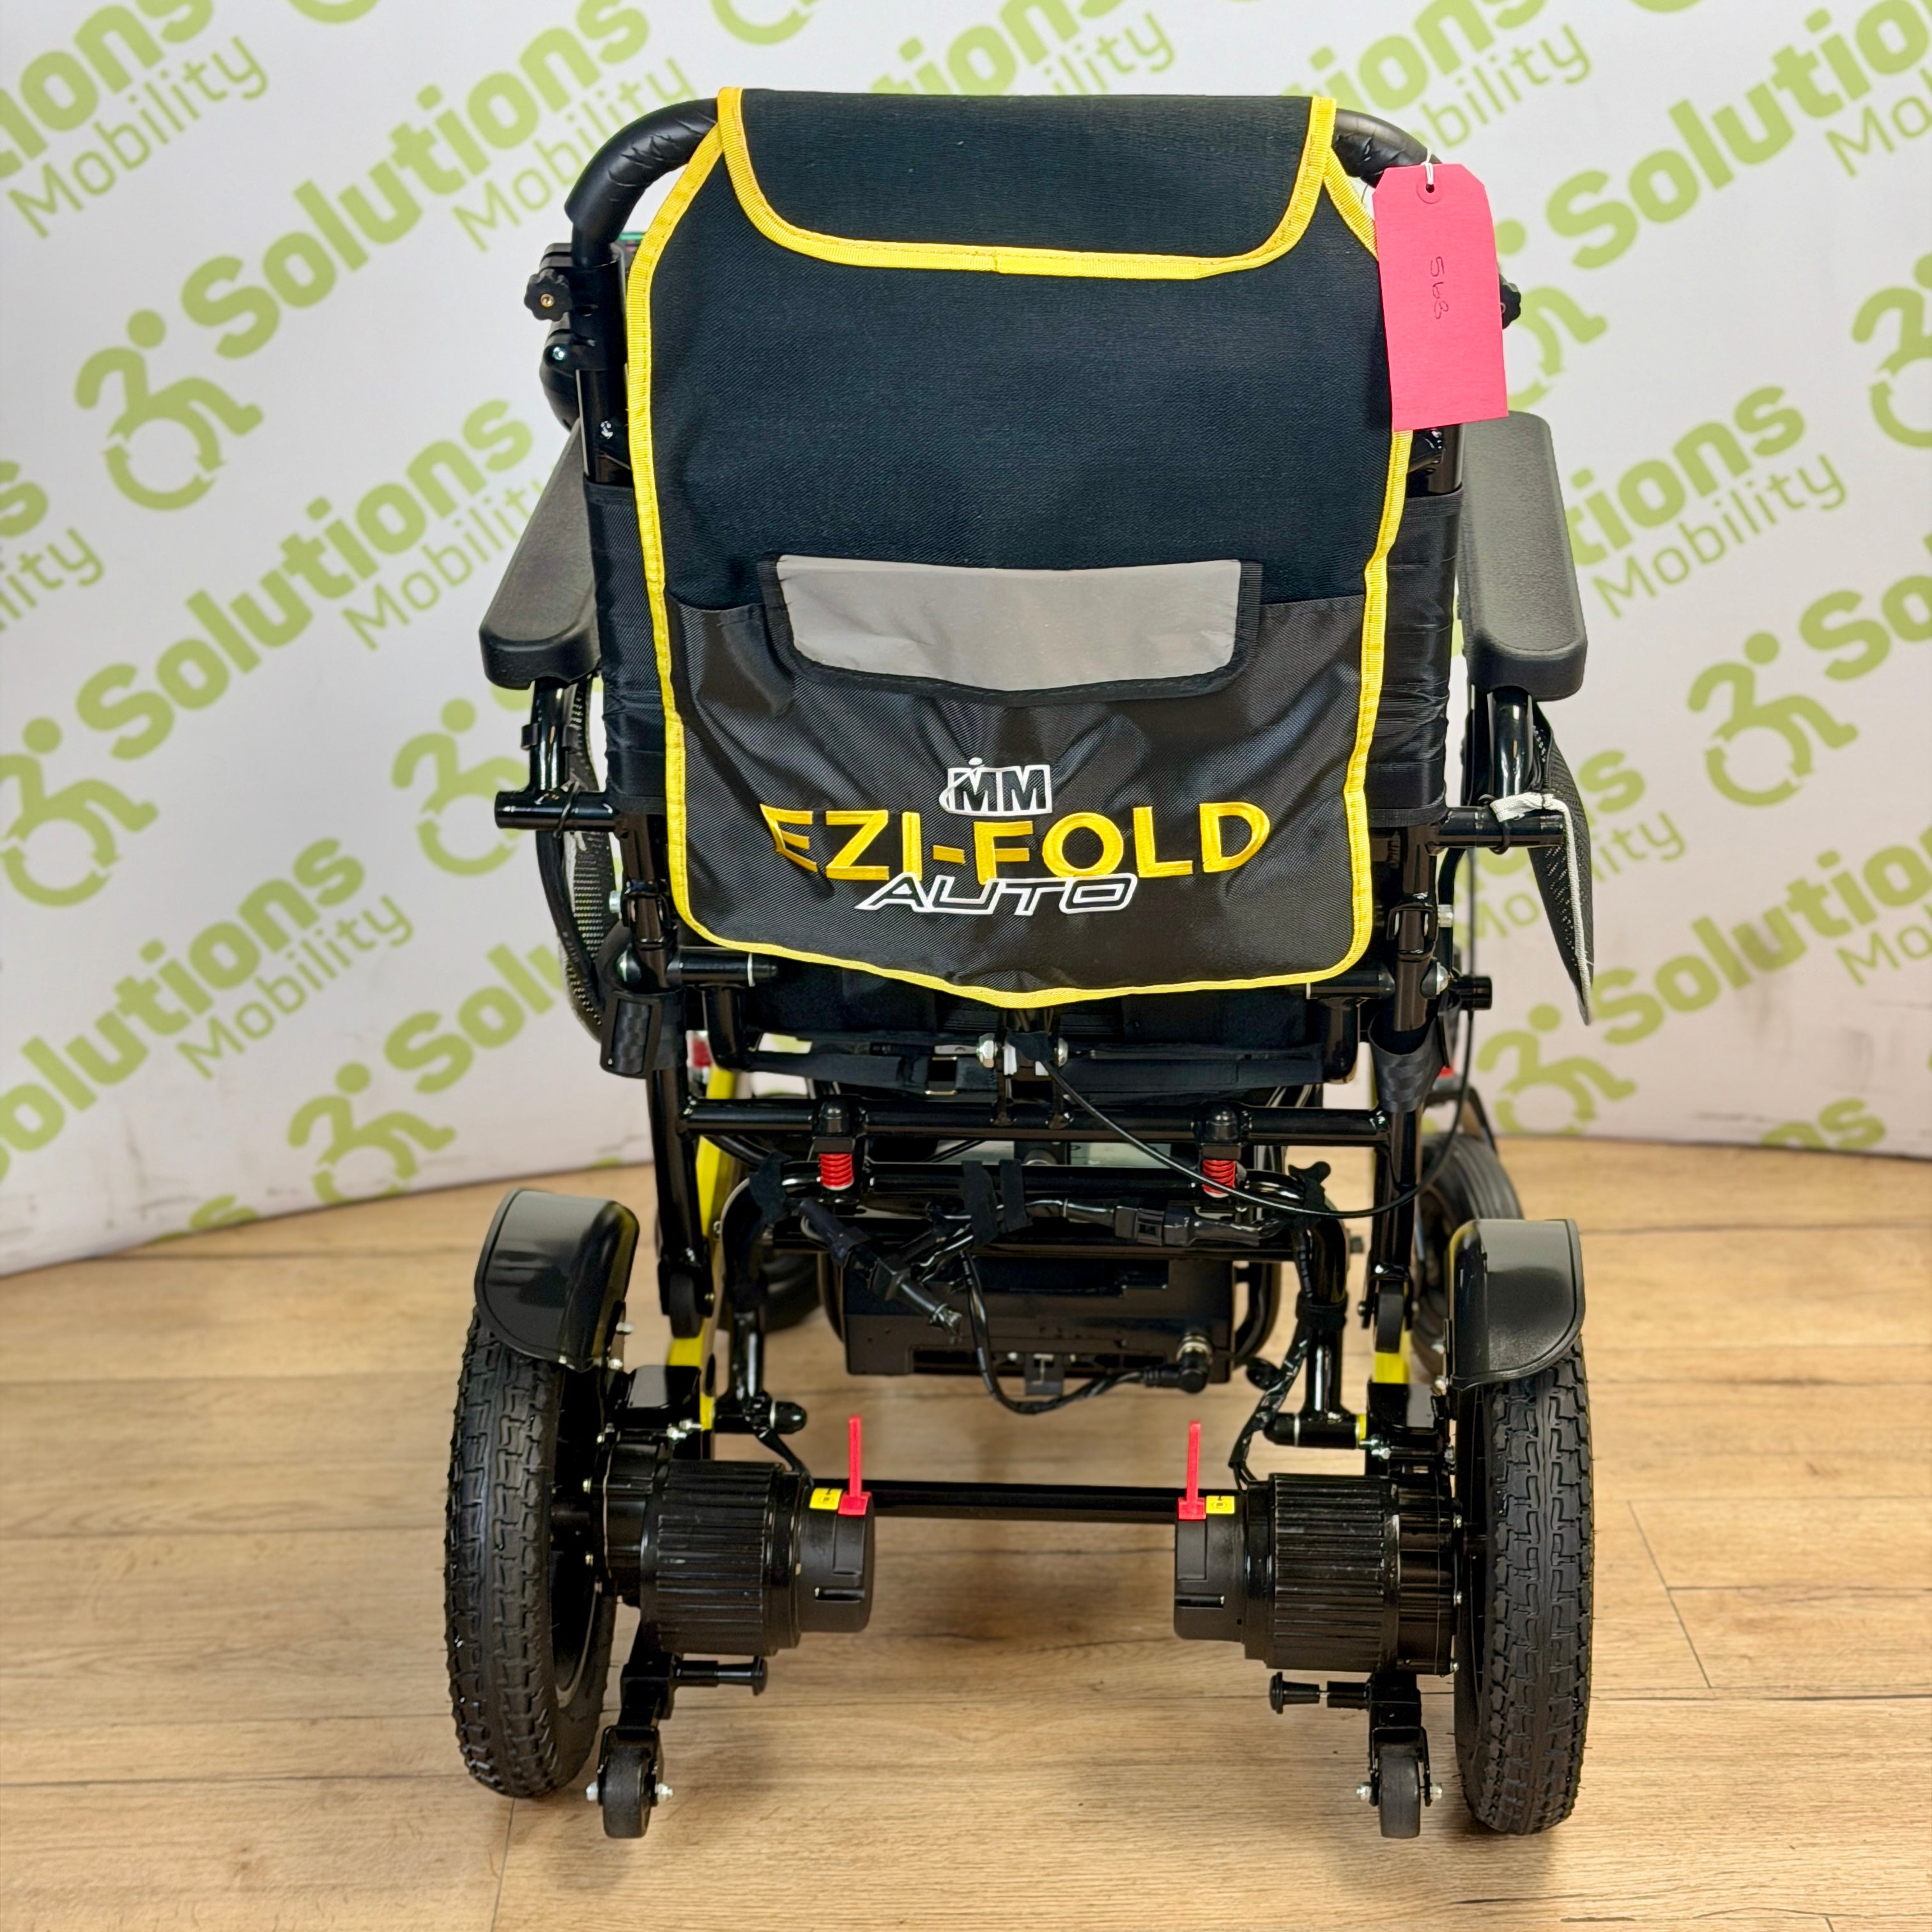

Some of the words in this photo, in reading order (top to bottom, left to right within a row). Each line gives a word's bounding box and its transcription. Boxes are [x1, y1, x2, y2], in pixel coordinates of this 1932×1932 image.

[8, 36, 267, 238] Mobility
[180, 0, 648, 358] Solutions
[1545, 0, 1932, 270] Solutio
[75, 400, 532, 760] Solutions
[341, 470, 555, 650] Mobilit
[1592, 454, 1847, 618] Mobility
[760, 802, 1271, 884] EZI-FOLD
[854, 871, 1138, 916] AUTO
[1590, 829, 1932, 1045] Solutio
[0, 838, 364, 1184] olutions
[176, 894, 414, 1080] Mobility
